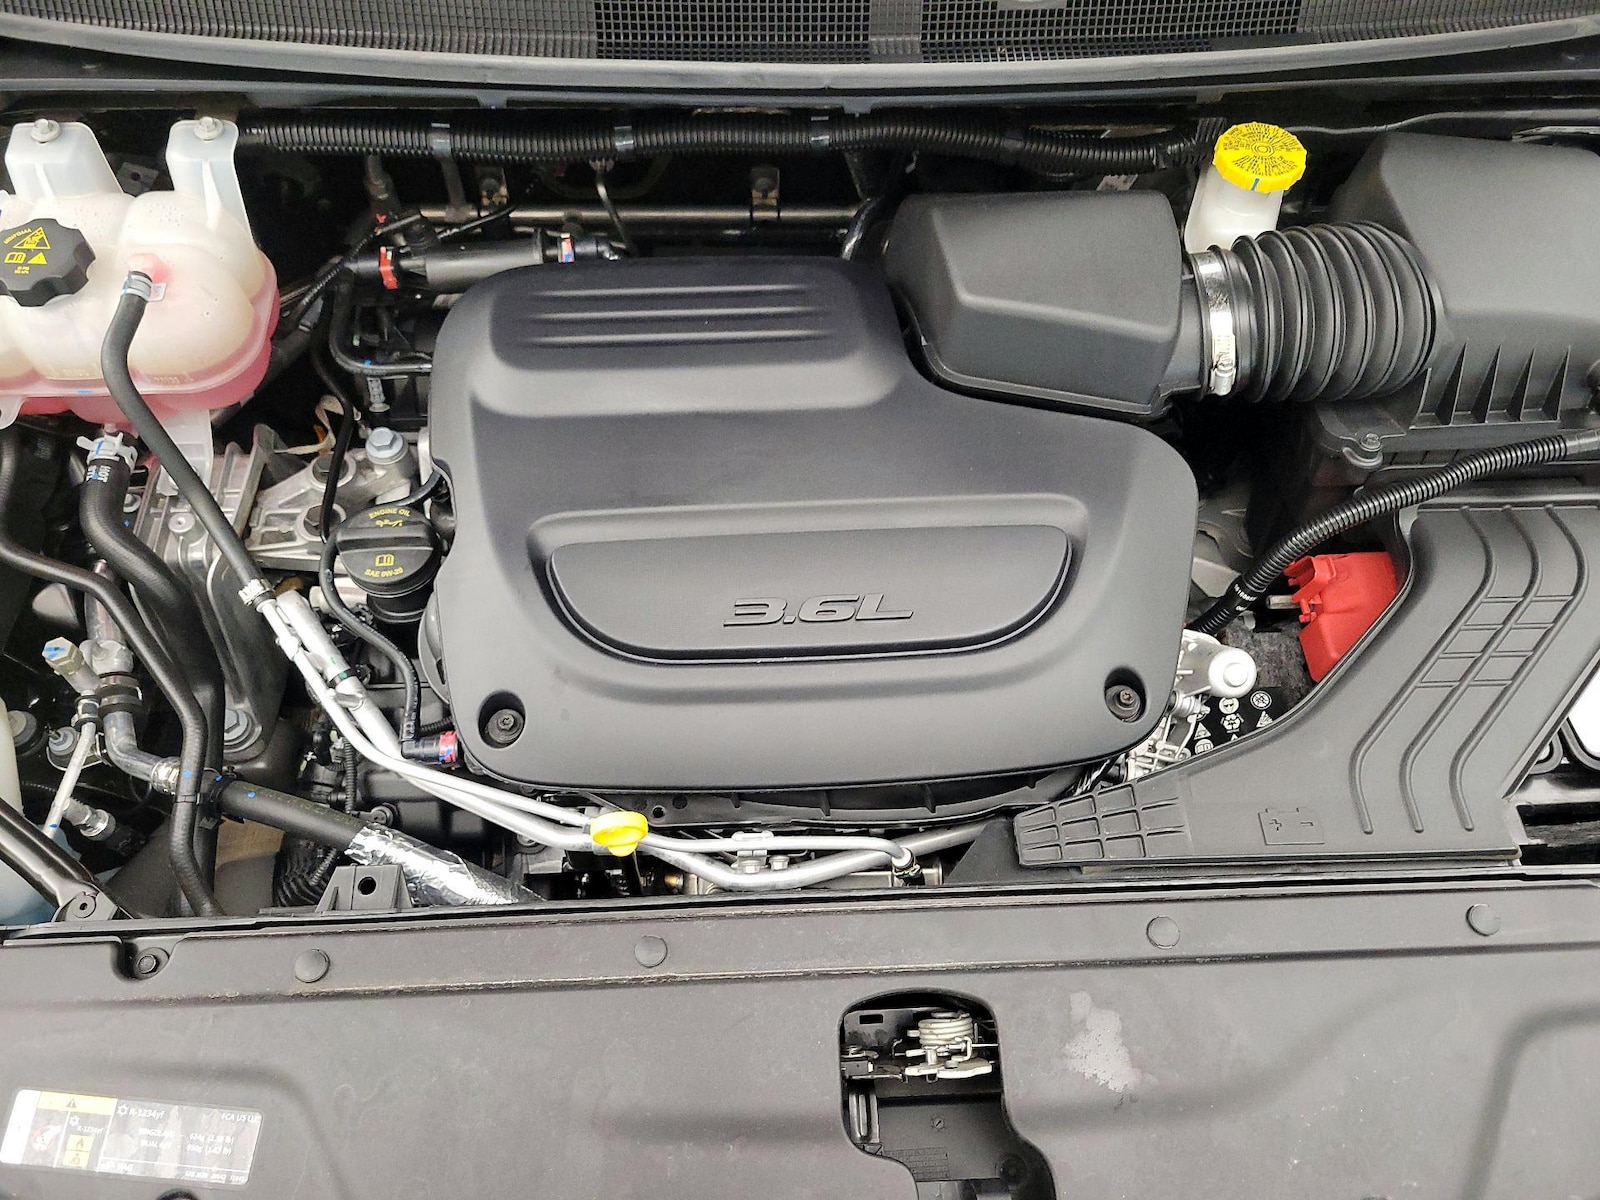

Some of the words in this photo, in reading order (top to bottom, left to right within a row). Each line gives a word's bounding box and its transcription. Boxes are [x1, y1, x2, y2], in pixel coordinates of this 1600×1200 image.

[369, 508, 398, 519] ENGINE
[399, 509, 411, 517] OIL
[365, 569, 380, 577] SAE
[381, 566, 404, 577] 0W-20
[723, 593, 914, 627] 3.6L
